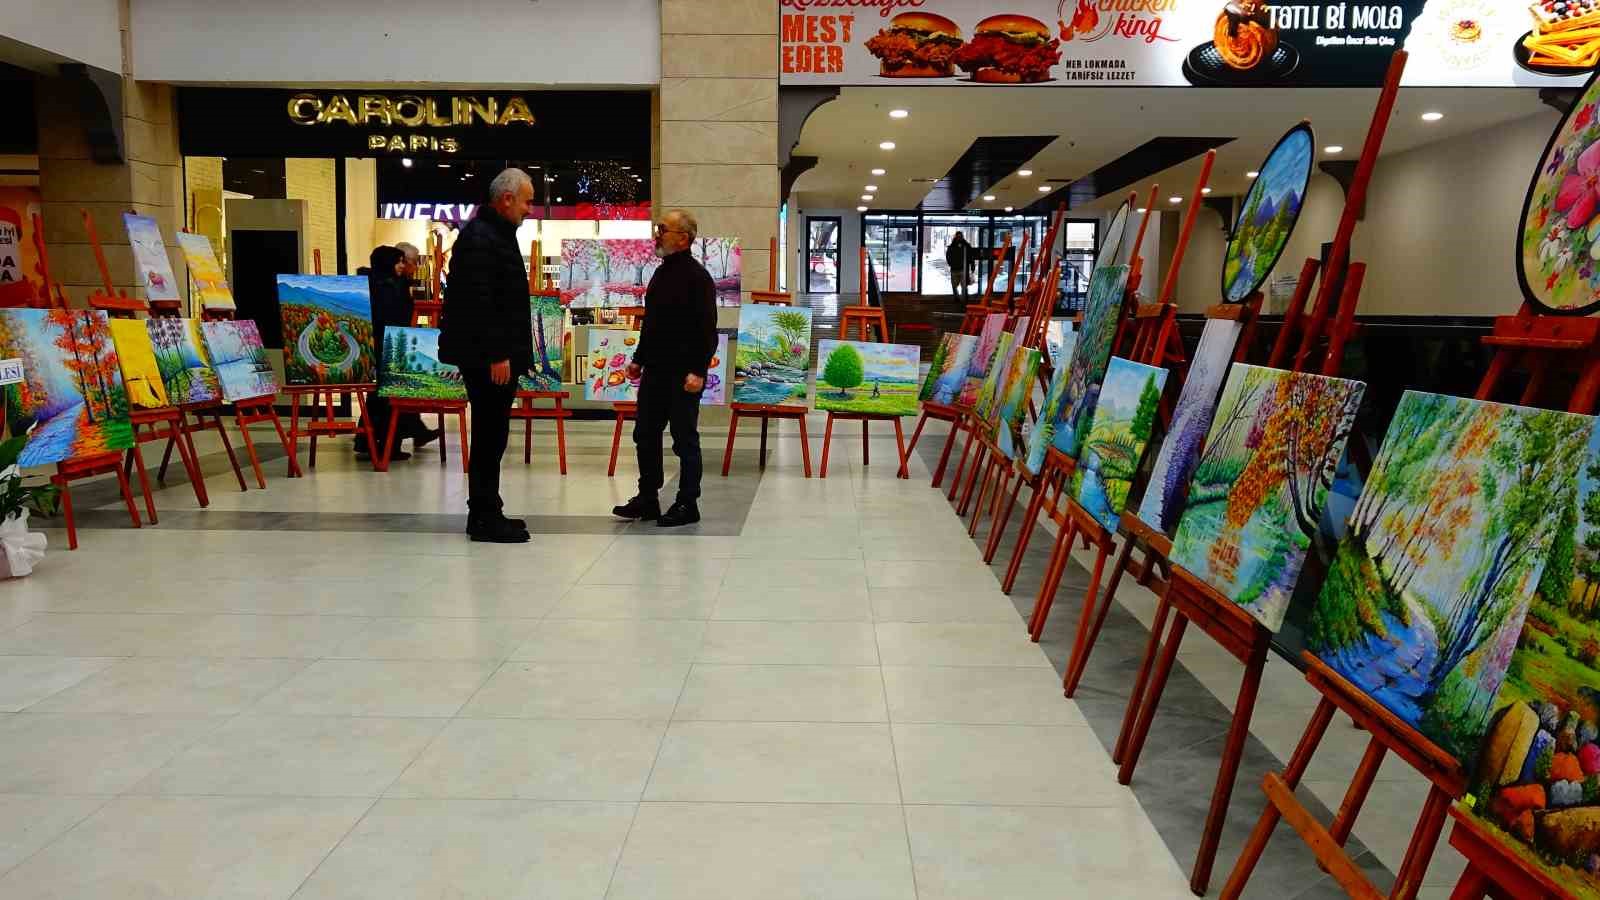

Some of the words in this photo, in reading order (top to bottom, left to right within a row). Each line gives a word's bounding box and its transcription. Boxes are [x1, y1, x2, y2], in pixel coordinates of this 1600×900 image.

[783, 15, 854, 42] MEST
[1113, 13, 1181, 43] king
[783, 45, 843, 73] EDER
[1066, 60, 1082, 68] HER
[1085, 60, 1126, 69] LOKMADA
[1107, 71, 1136, 80] LEZZET
[287, 94, 536, 126] CAROLINA
[368, 135, 458, 152] PARIS
